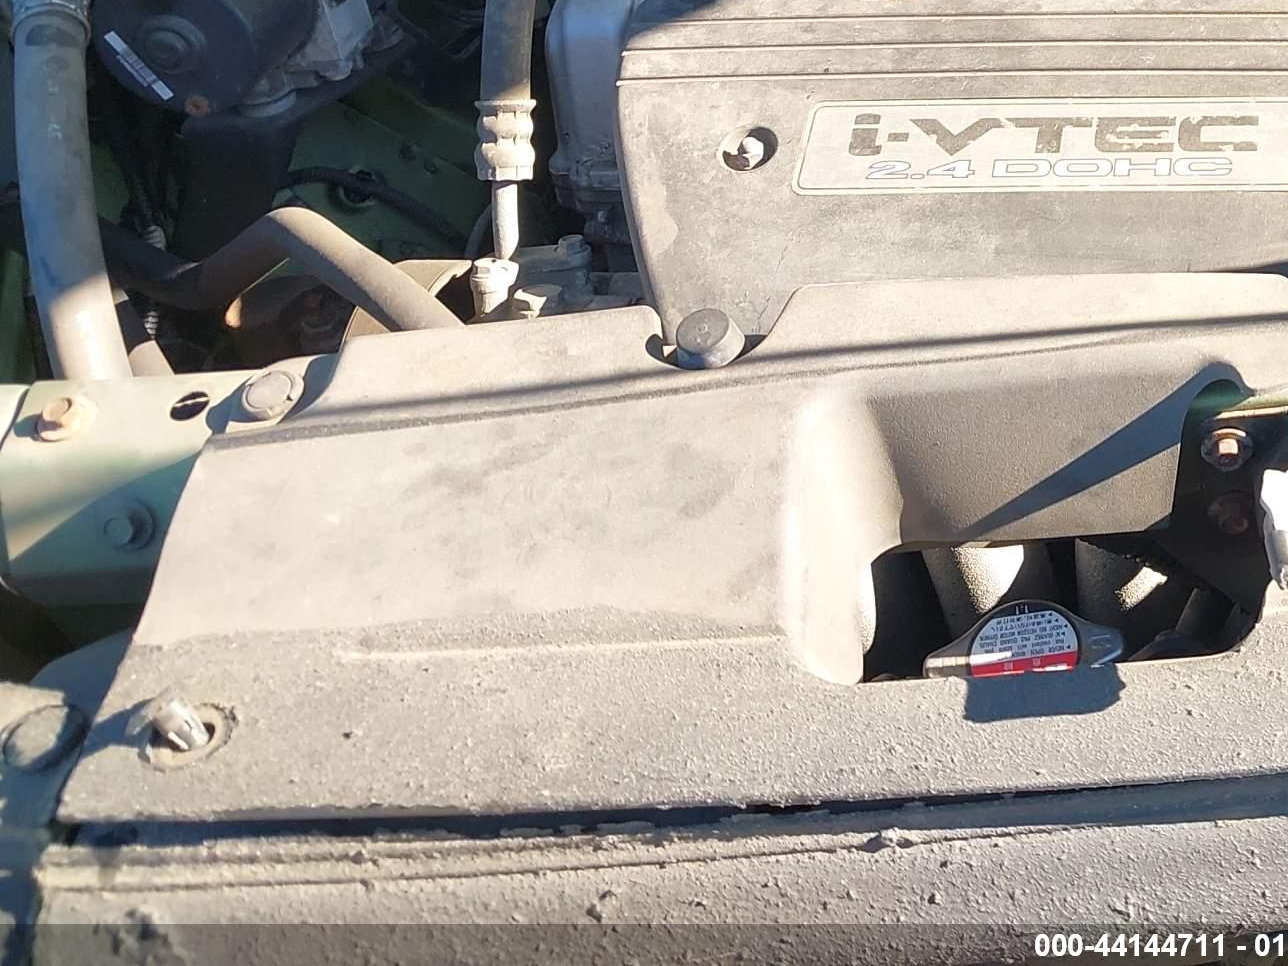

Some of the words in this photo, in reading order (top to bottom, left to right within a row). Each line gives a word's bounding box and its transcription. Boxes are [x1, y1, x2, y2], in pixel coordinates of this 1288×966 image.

[848, 113, 1260, 156] i-VTEC
[865, 159, 975, 180] 2.4
[991, 157, 1233, 178] DOHC
